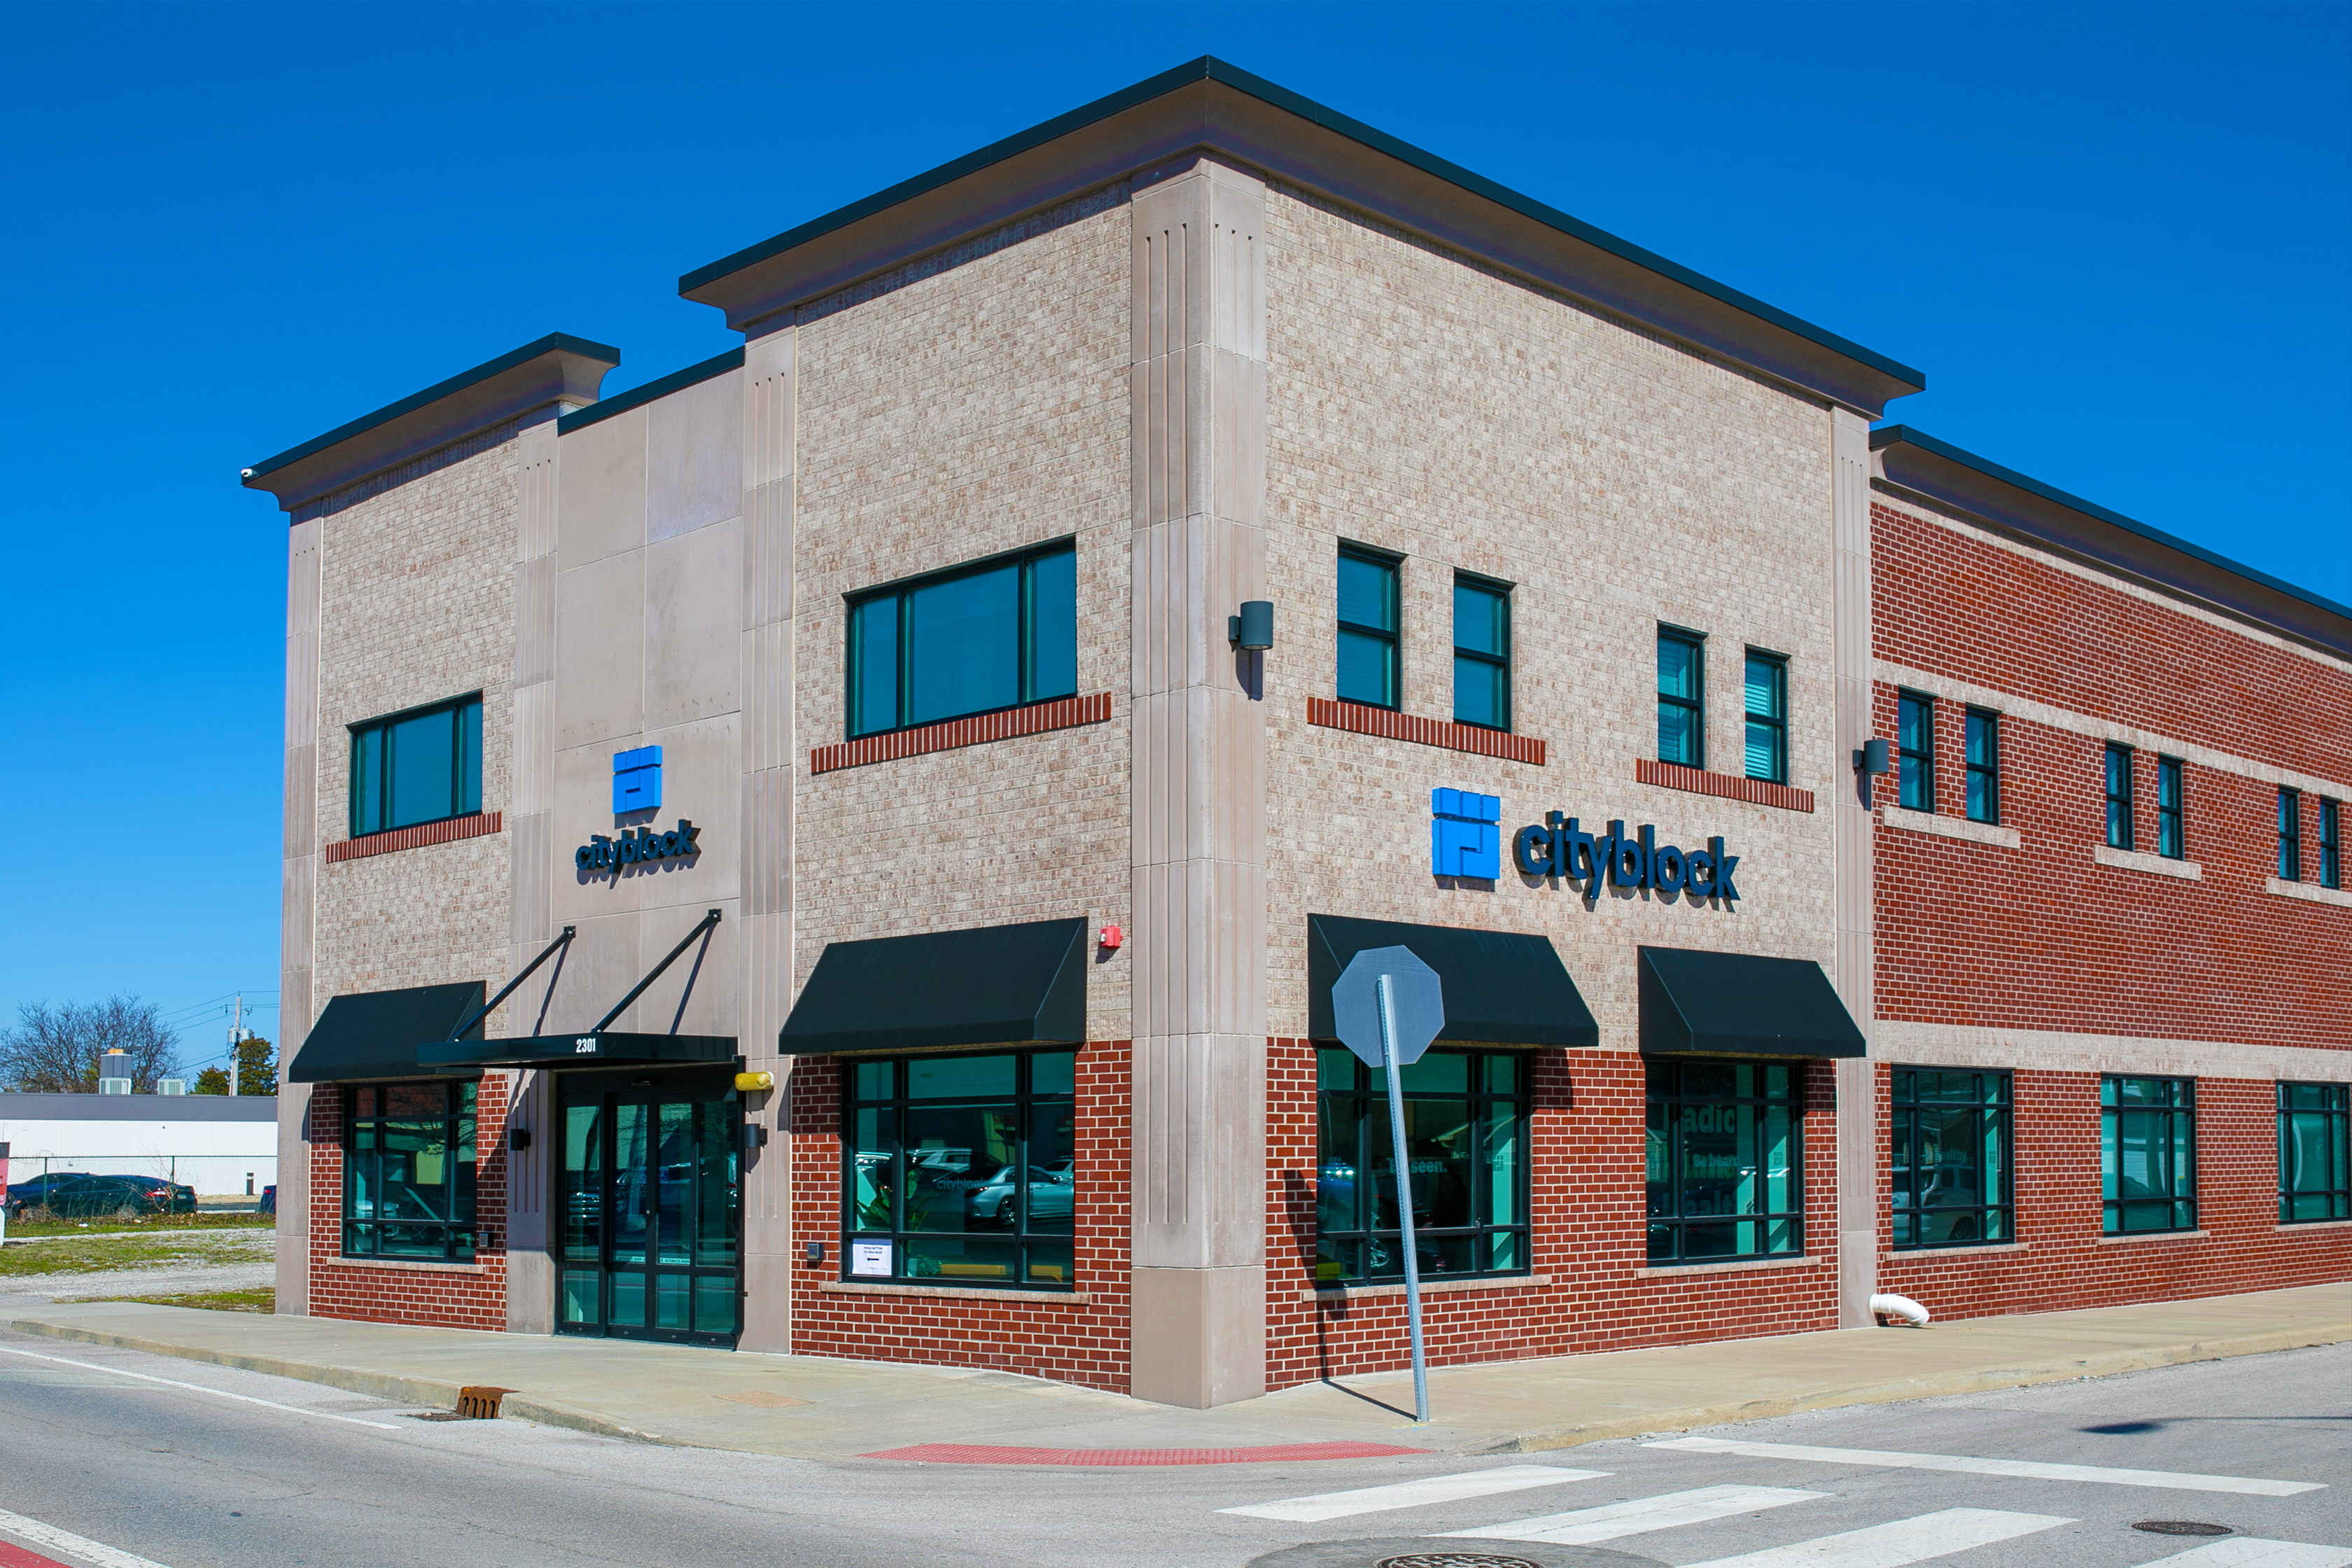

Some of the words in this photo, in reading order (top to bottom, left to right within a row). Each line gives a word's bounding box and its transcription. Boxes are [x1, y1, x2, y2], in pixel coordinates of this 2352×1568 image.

[575, 819, 695, 874] cityblock
[1516, 810, 1741, 901] cityblock
[576, 1038, 596, 1053] 2301
[1410, 1160, 1448, 1174] seen.
[1693, 1154, 1707, 1168] Be
